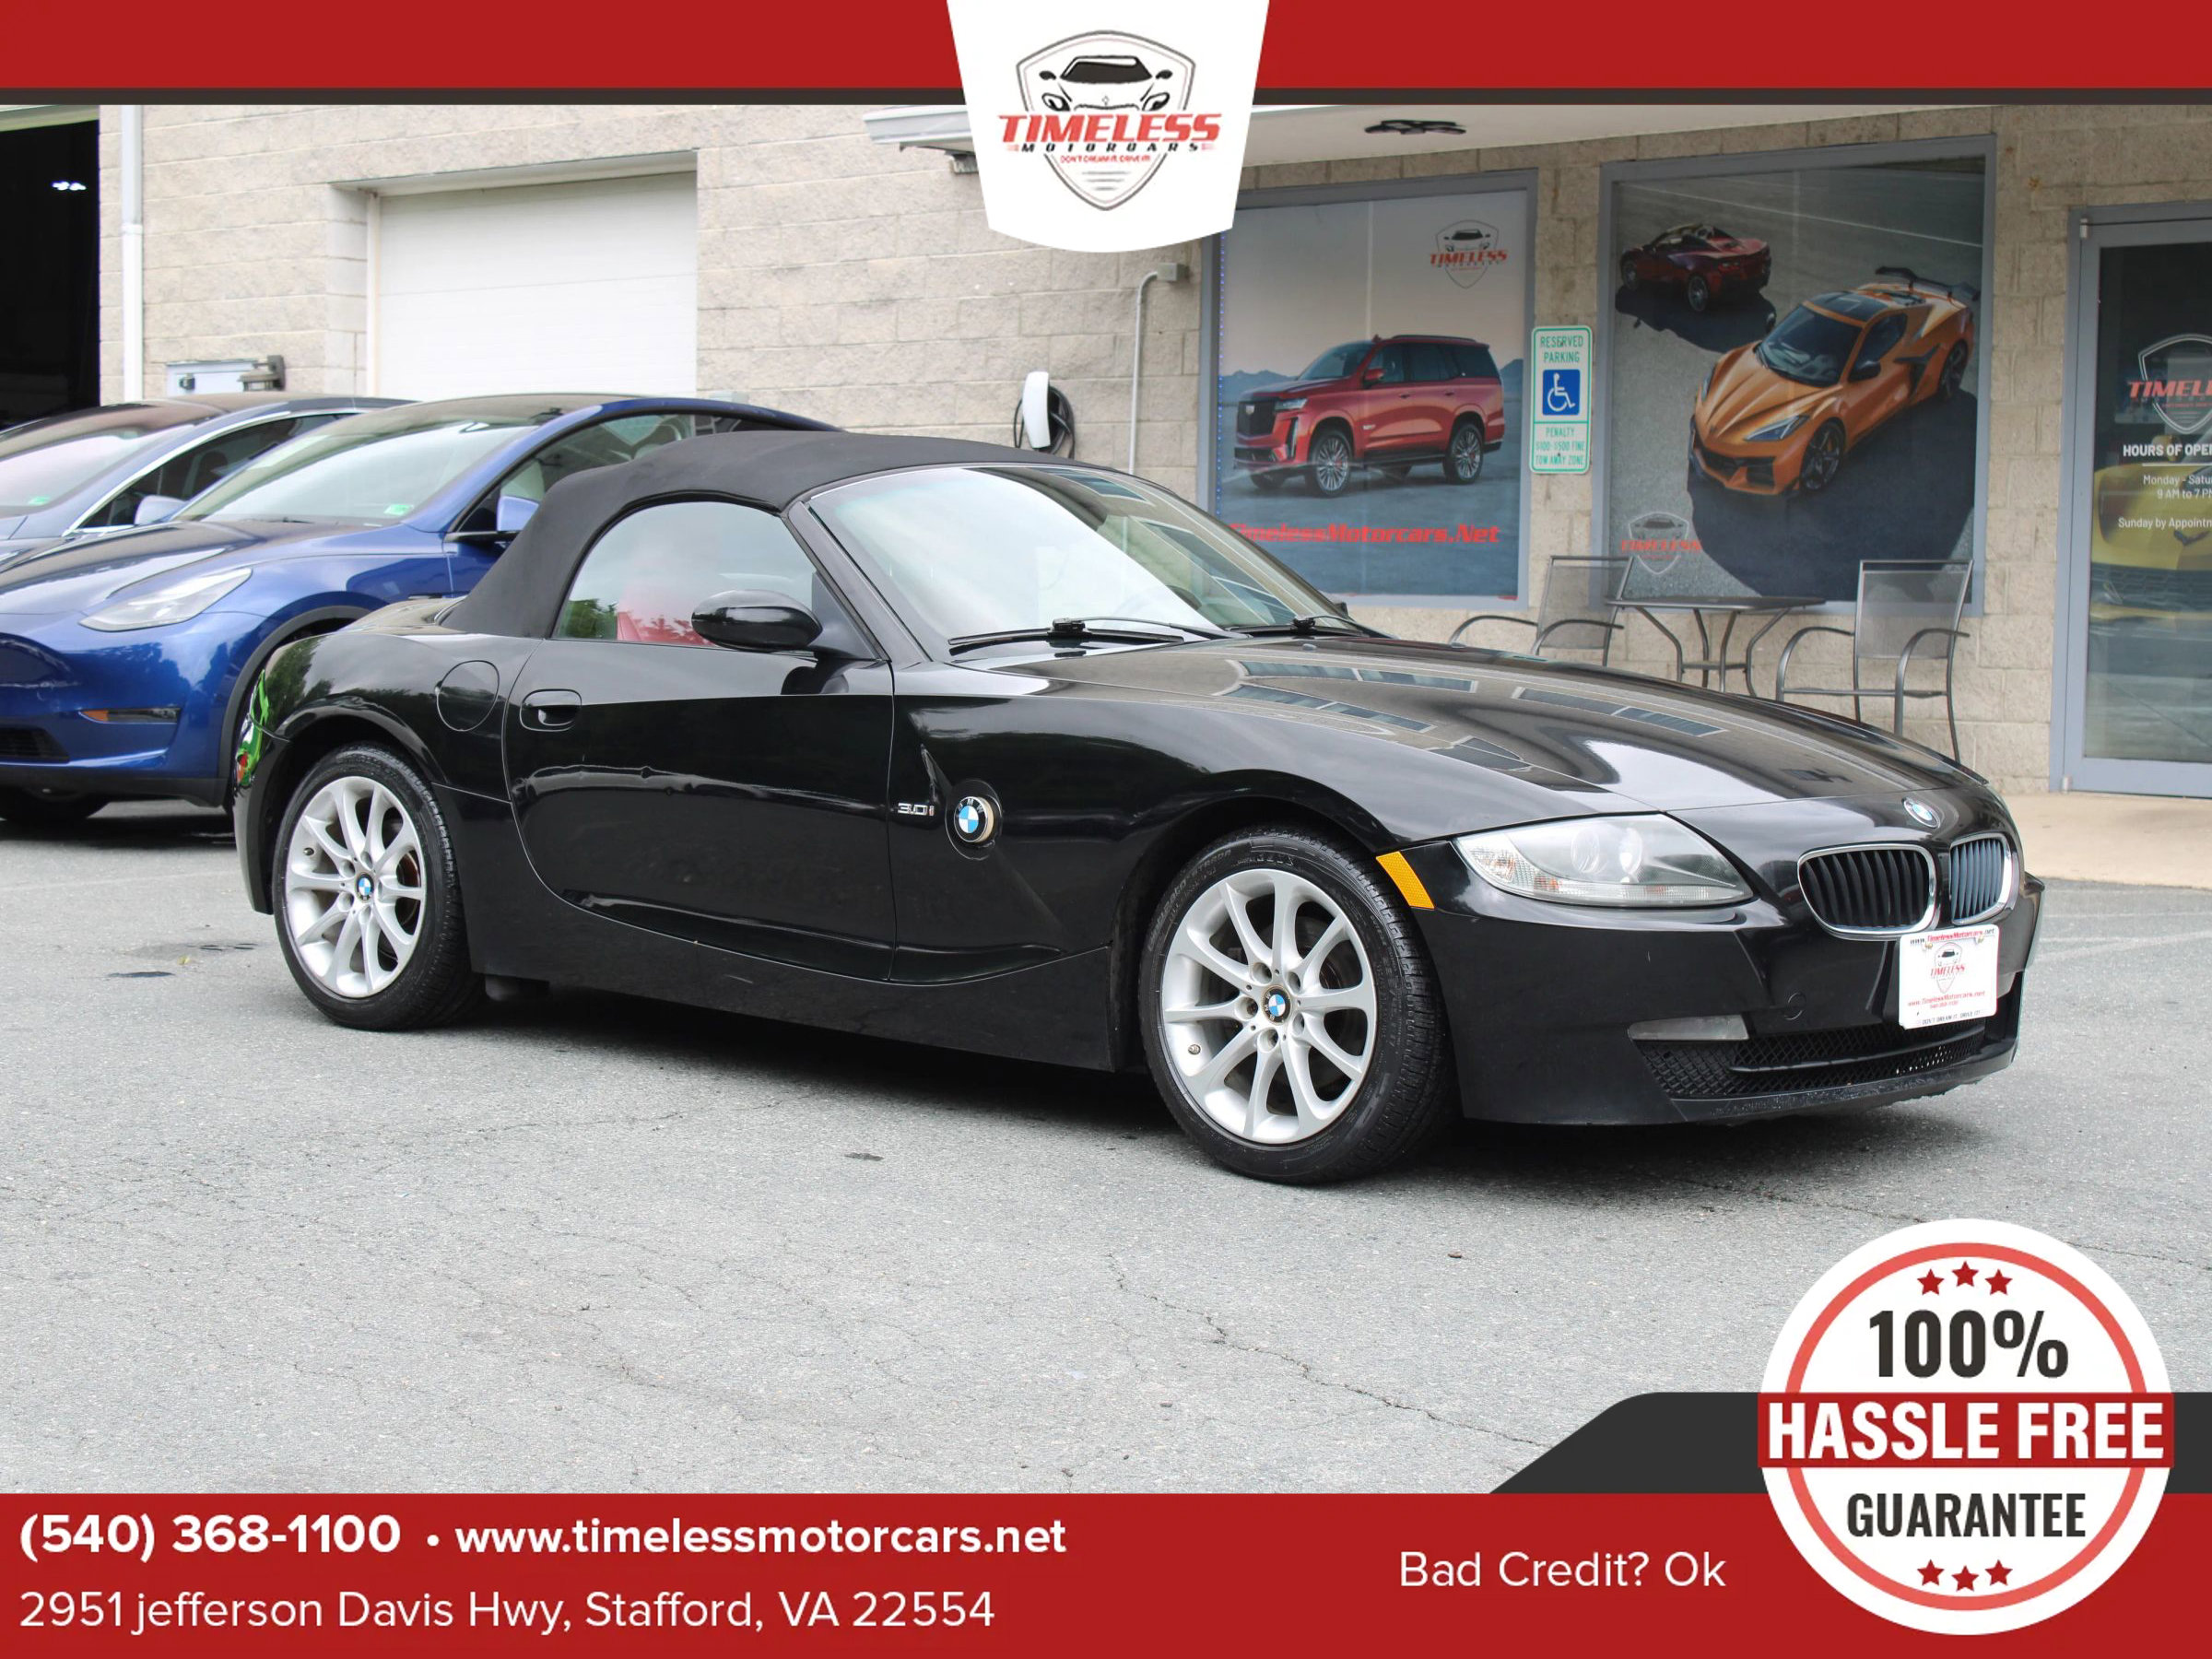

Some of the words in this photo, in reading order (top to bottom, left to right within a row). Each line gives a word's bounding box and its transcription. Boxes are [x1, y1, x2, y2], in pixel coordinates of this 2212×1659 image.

[1540, 335, 1583, 348] RESERVED
[1543, 352, 1580, 363] PARKING
[2123, 444, 2164, 457] HOURS
[2166, 444, 2183, 456] OF
[2143, 475, 2181, 488] Monday
[2157, 488, 2163, 500] 9
[2166, 488, 2180, 499] AM
[2183, 489, 2193, 499] to
[2195, 488, 2201, 499] 7
[2118, 517, 2154, 530] Sunday
[2155, 517, 2167, 530] by
